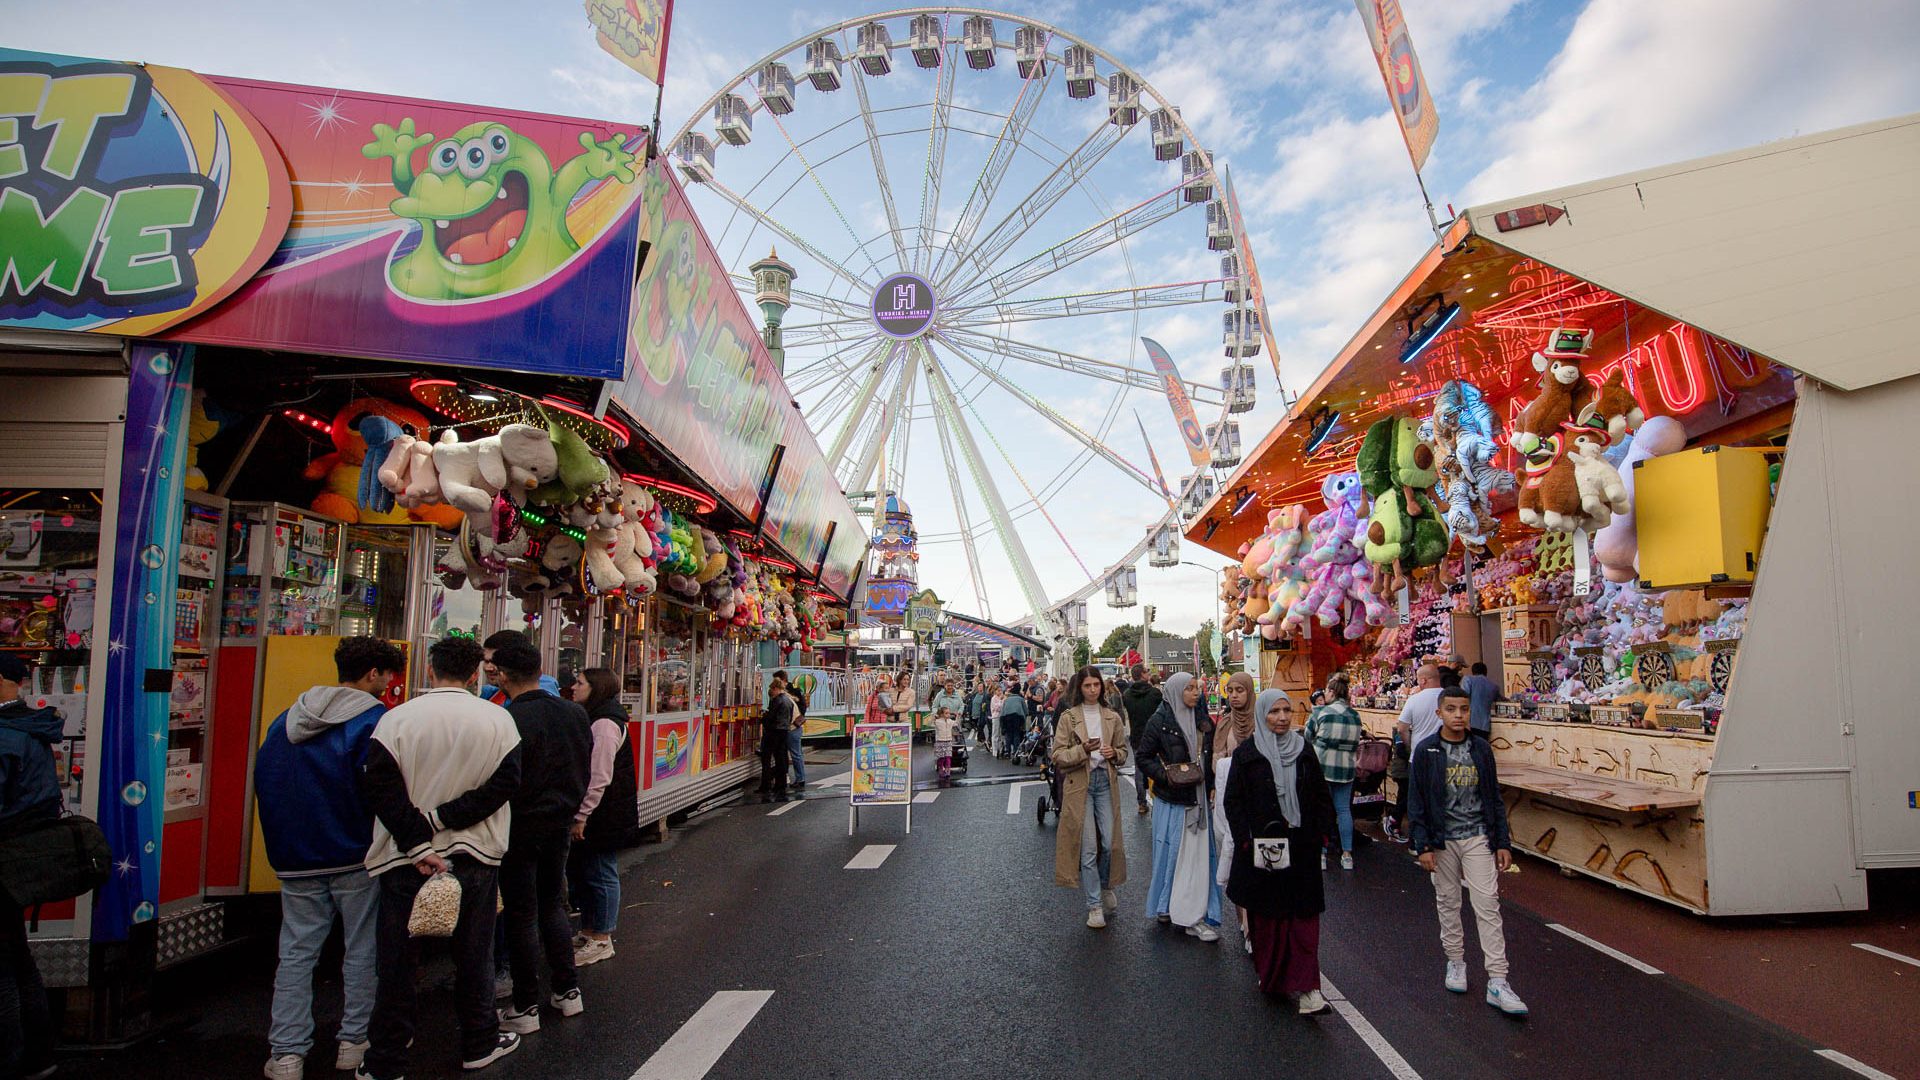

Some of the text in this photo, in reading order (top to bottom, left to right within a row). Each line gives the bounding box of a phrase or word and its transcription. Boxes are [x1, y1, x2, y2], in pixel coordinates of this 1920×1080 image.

[893, 283, 916, 310] H
[1575, 580, 1588, 595] 3X
[1400, 613, 1409, 624] 2X
